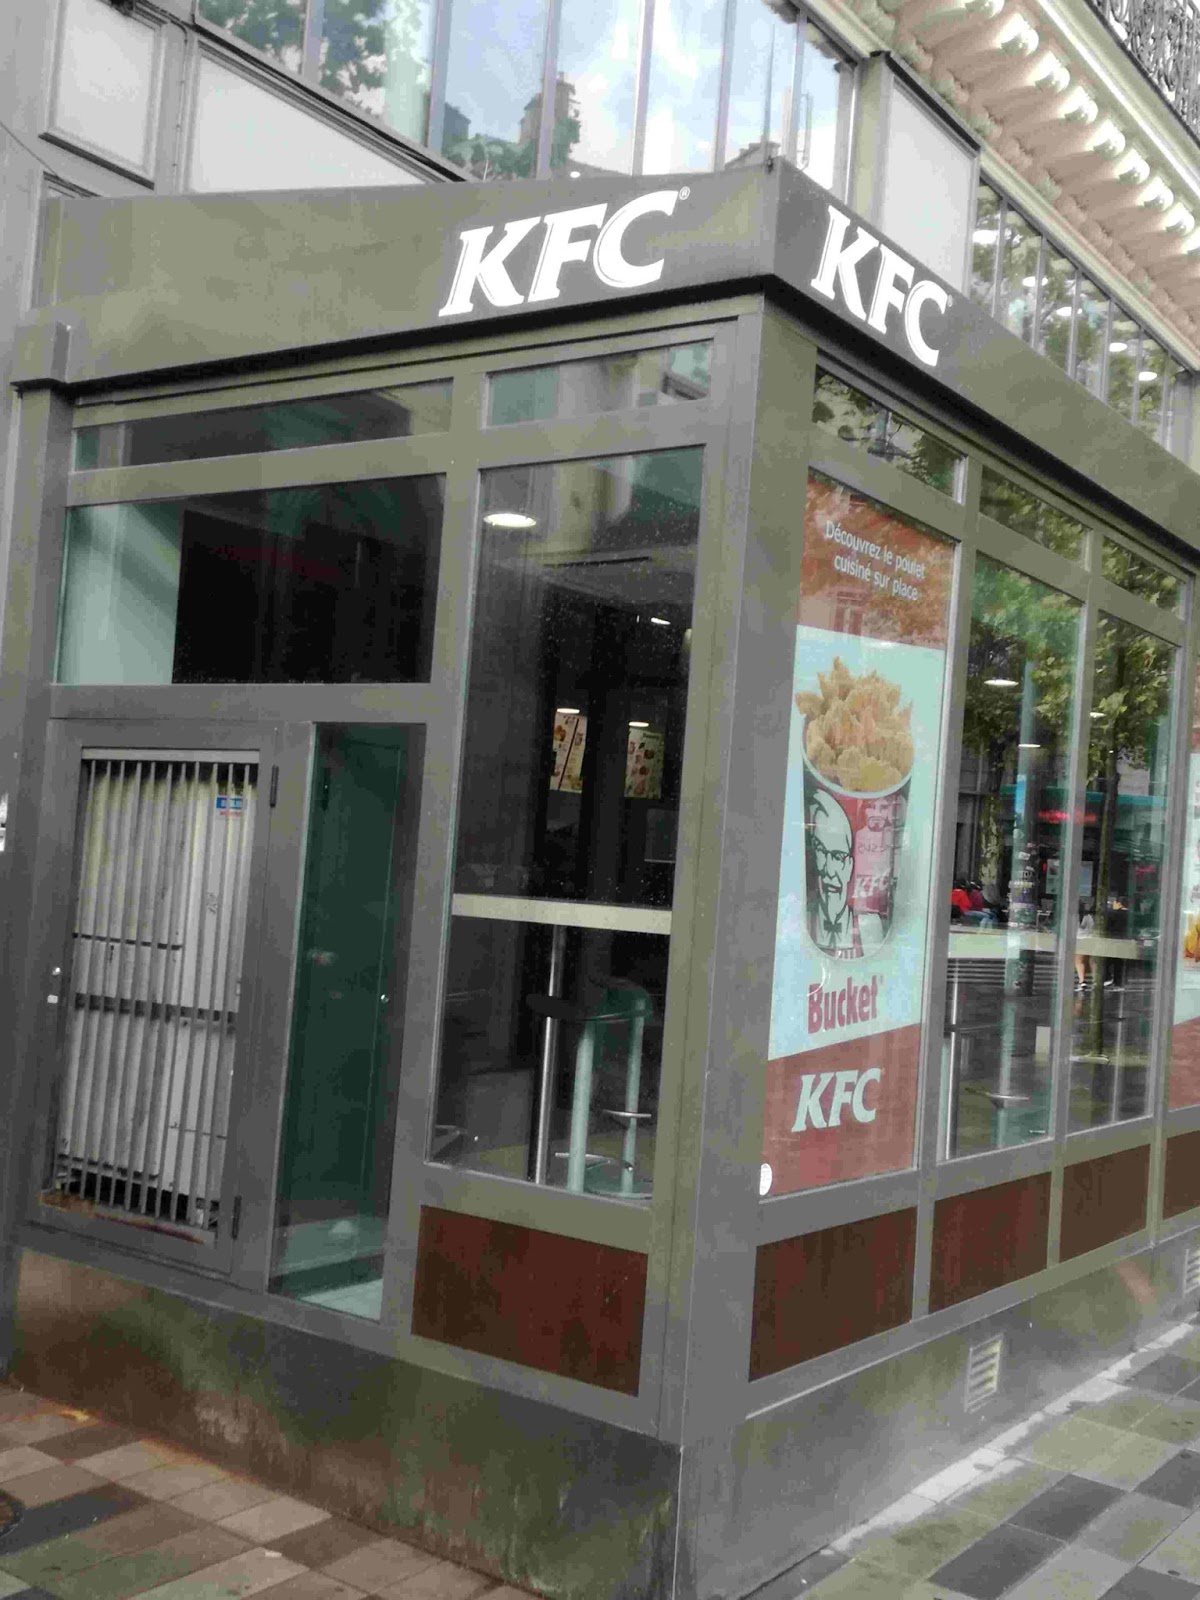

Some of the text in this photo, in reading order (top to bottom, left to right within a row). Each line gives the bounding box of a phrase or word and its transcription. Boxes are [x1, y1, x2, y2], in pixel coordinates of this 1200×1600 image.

[438, 190, 679, 317] KFC
[811, 205, 948, 367] KFC
[826, 520, 926, 579] Découvrez le poulet
[834, 555, 919, 601] cuisiné sur place
[807, 975, 878, 1034] Bucket
[791, 1068, 881, 1132] KFC
